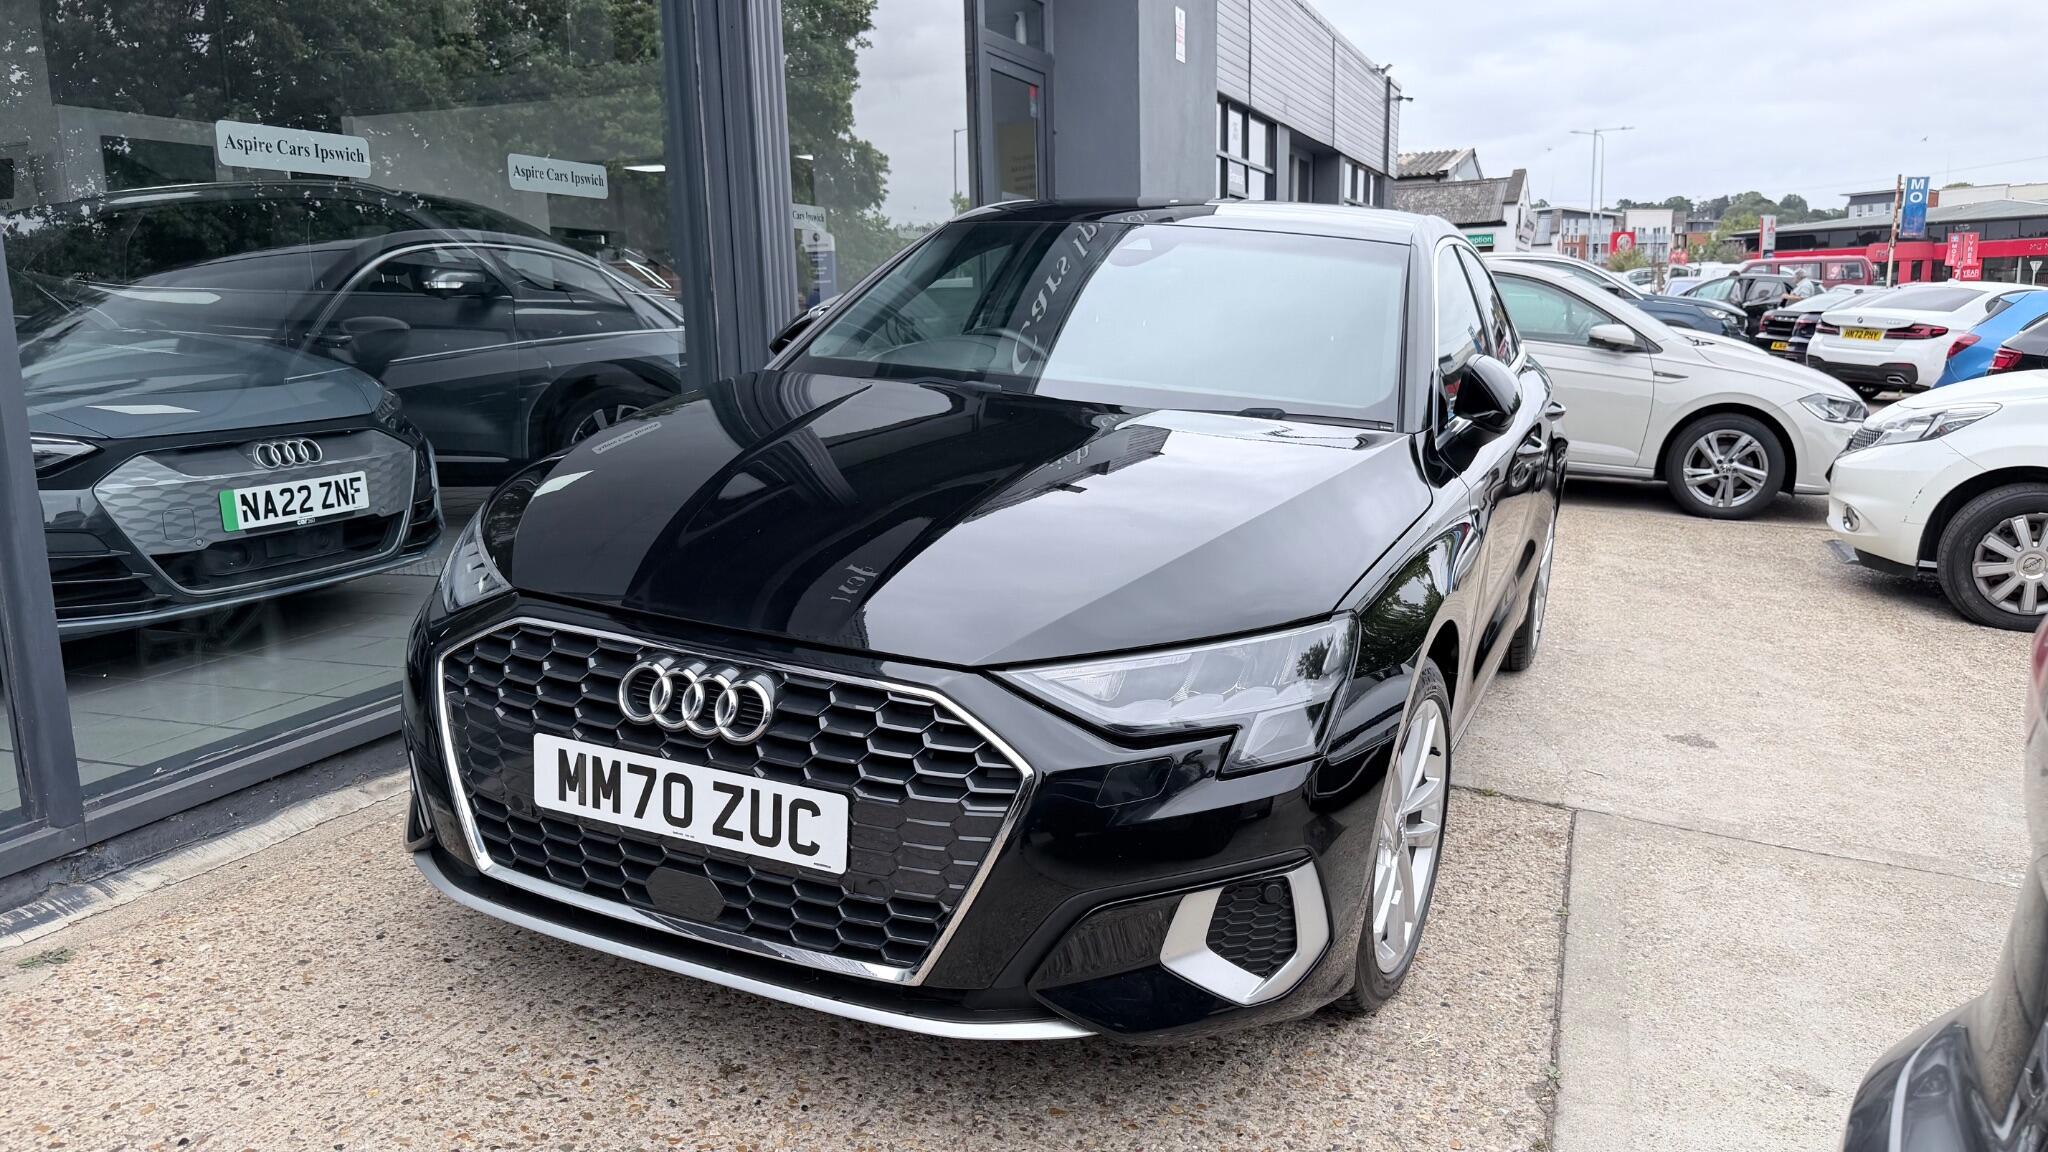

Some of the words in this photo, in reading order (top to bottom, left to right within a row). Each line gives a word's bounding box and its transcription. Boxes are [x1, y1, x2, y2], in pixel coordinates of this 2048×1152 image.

[224, 133, 273, 155] Aspire
[277, 139, 311, 157] Cars
[314, 143, 365, 163] Ipswich
[513, 164, 544, 181] Aspire
[546, 168, 569, 182] Cars
[571, 171, 604, 187] Ipswich
[1471, 236, 1493, 247] eption
[240, 484, 314, 522] NA22
[319, 476, 362, 510] ZNF
[557, 748, 694, 829] MM70
[712, 780, 822, 857] ZUC
